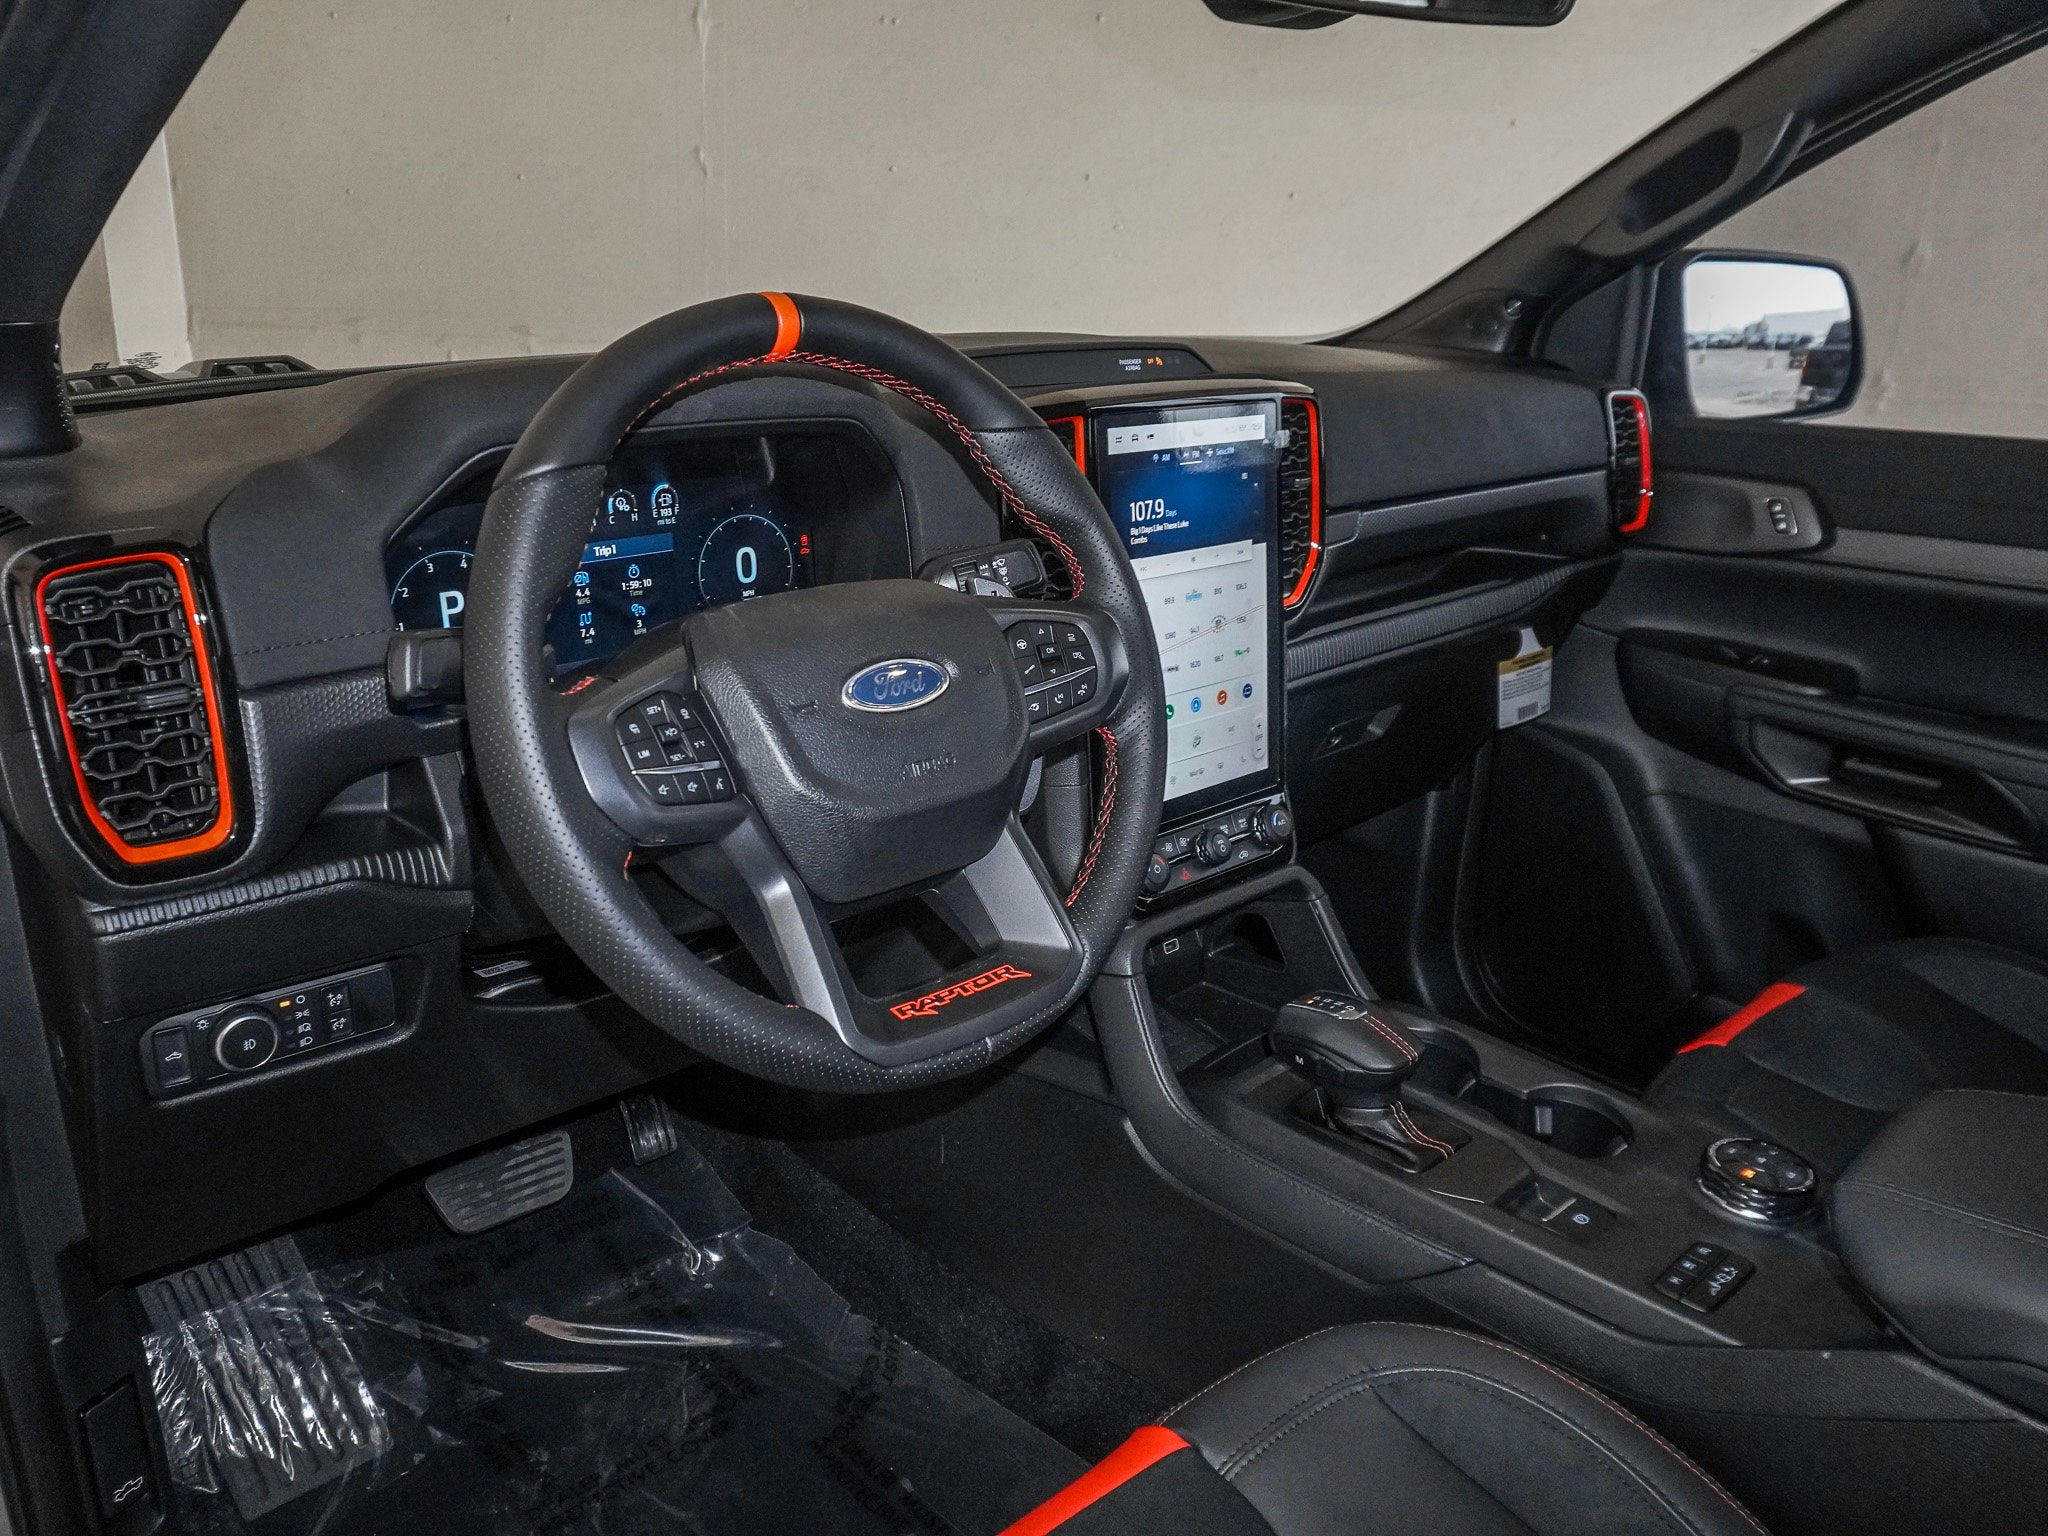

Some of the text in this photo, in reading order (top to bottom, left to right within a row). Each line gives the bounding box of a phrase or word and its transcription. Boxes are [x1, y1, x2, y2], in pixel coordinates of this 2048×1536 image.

[653, 509, 658, 517] E
[660, 508, 672, 517] 193
[674, 507, 680, 515] F
[1130, 499, 1164, 522] 107.9
[609, 515, 615, 524] C
[631, 513, 638, 521] H
[427, 563, 434, 573] 3
[460, 559, 467, 568] 4
[736, 546, 757, 583] 0
[622, 578, 652, 590] 1:59:10
[401, 588, 409, 597] 2
[576, 588, 590, 597] 4.4
[439, 591, 465, 628] P
[580, 627, 595, 637] 7.4
[889, 964, 1032, 1020] RAPTOR
